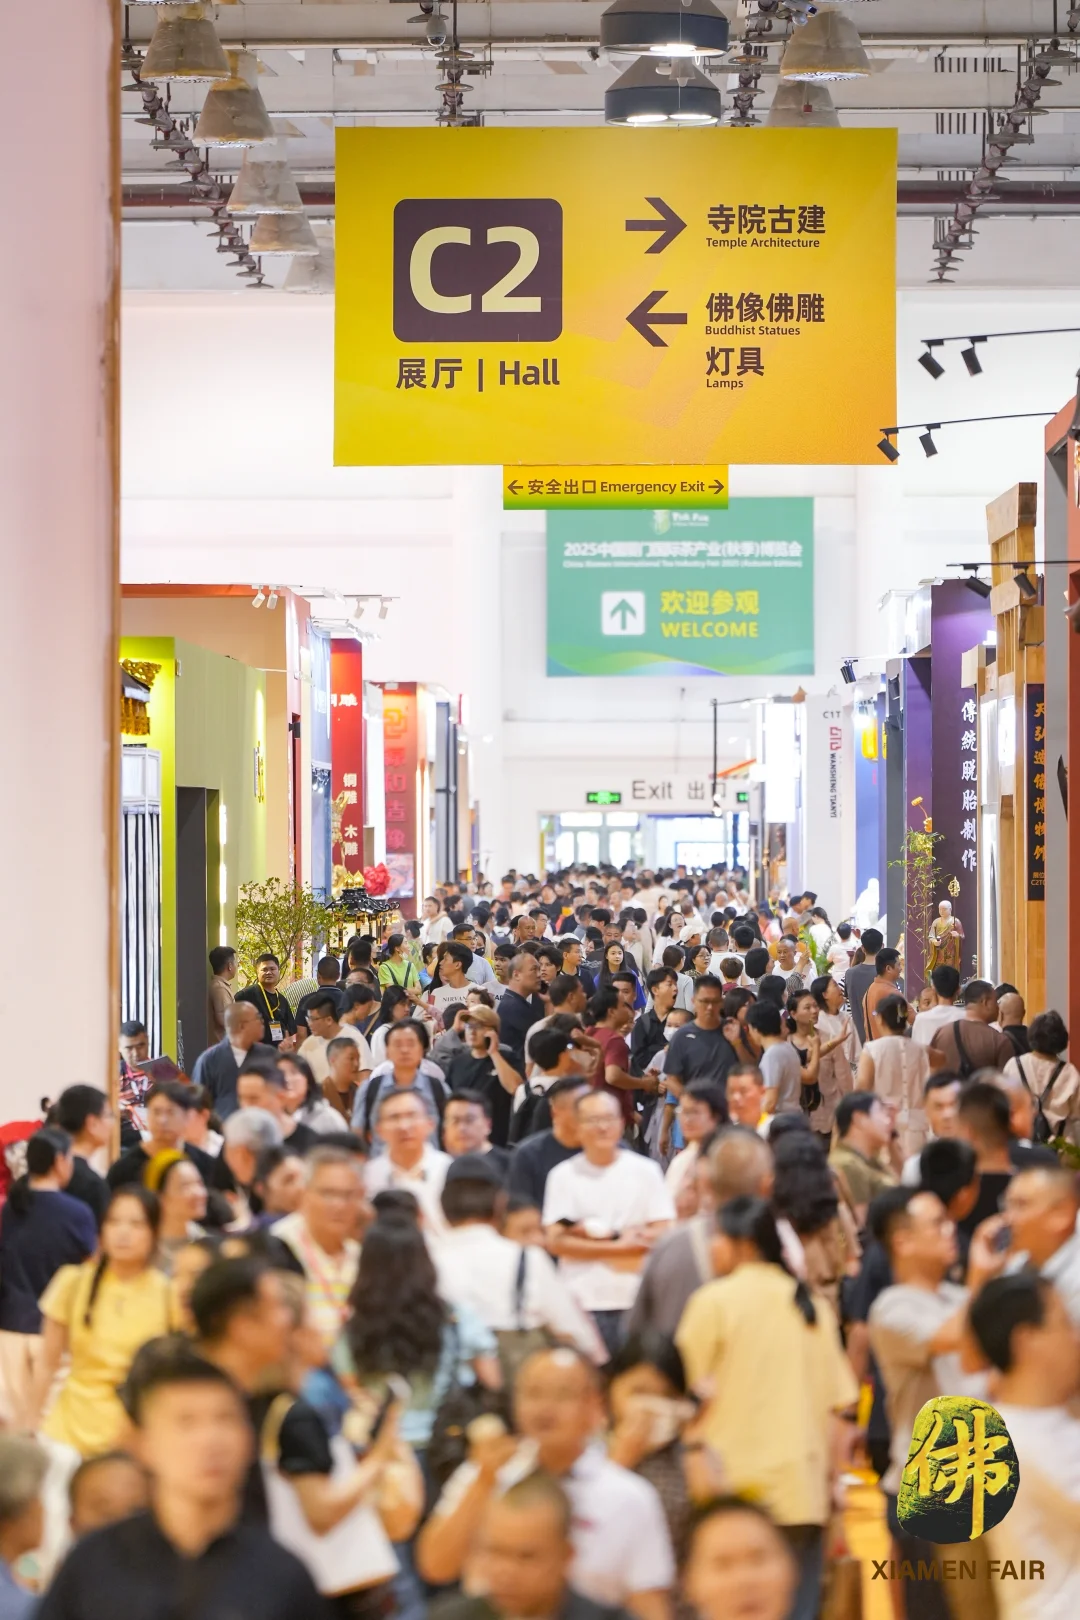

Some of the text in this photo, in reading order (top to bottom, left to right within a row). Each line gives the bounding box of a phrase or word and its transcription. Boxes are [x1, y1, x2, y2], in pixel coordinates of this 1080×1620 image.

[707, 204, 826, 234] 寺院古建
[706, 237, 820, 249] Temple Architecture
[409, 226, 542, 314] C2
[705, 292, 826, 322] 佛像佛雕
[705, 325, 801, 335] Buddhist Statues
[396, 358, 560, 389] 展厅 Hall
[706, 346, 765, 377] 灯具
[706, 379, 744, 390] Lamps
[527, 479, 705, 495] 安全出口 Emergency Exit
[660, 590, 759, 615] 欢迎参观
[660, 621, 759, 638] WELCOME
[632, 780, 673, 800] Exit
[343, 825, 358, 856] 木雕
